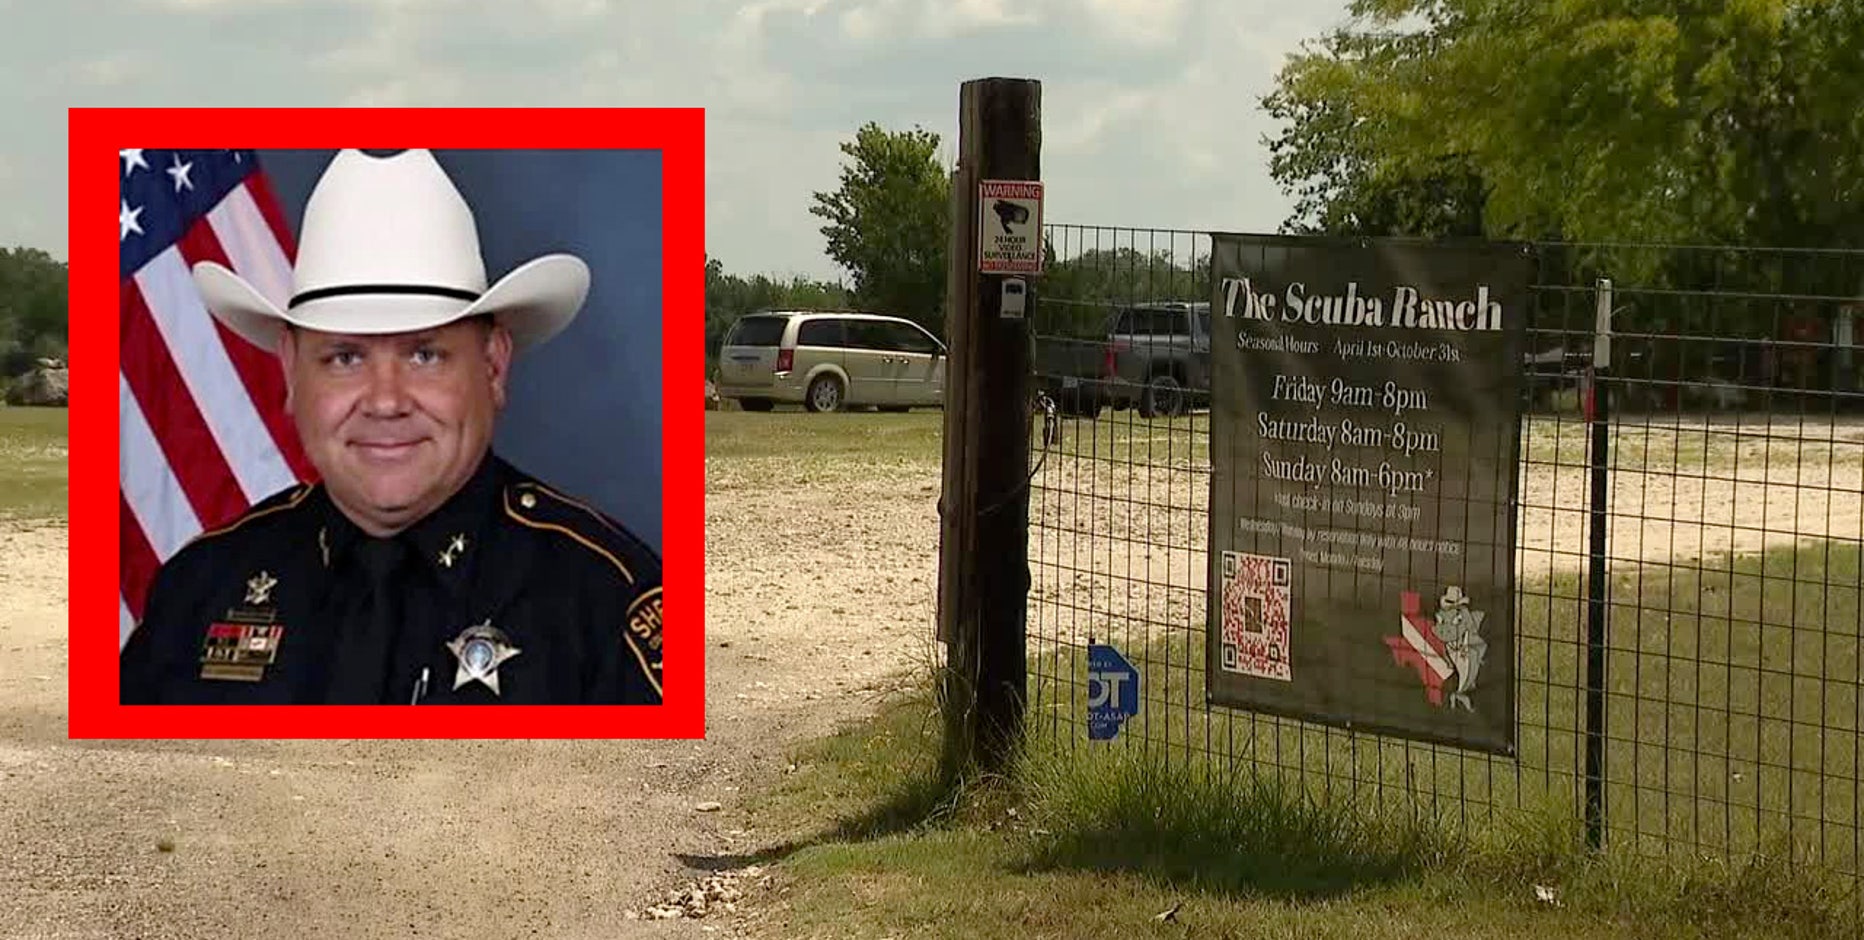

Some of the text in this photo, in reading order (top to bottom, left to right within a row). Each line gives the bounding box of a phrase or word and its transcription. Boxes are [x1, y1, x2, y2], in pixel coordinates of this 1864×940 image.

[984, 183, 1040, 198] WARNING
[1222, 277, 1504, 331] The Scuba Ranch
[1285, 335, 1319, 354] Hours
[1333, 338, 1364, 361] April
[1272, 375, 1429, 416] Friday 9am-8pm
[1258, 412, 1440, 456] Saturday 8am-8pm
[1263, 451, 1327, 489] Sunday
[1345, 497, 1384, 518] Sundays
[1398, 503, 1421, 520] 3pm
